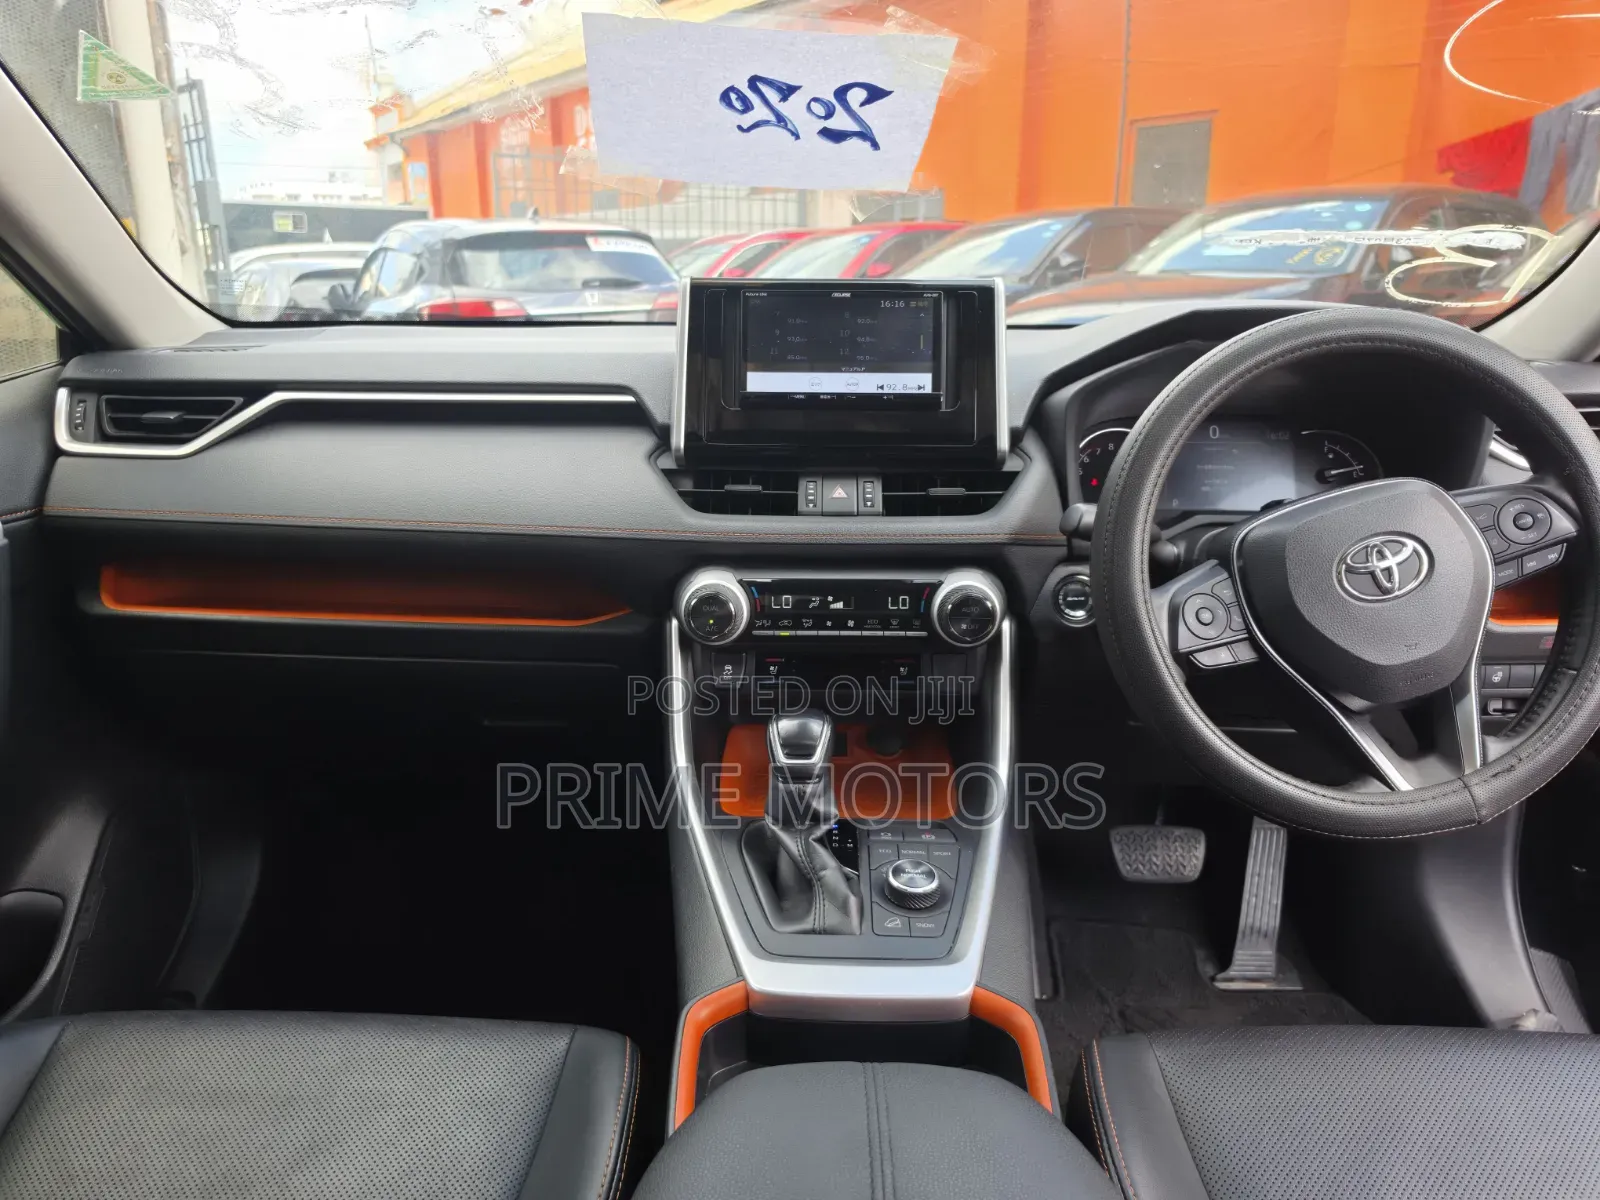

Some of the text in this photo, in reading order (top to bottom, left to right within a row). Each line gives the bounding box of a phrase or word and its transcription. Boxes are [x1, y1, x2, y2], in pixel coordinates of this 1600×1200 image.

[880, 300, 905, 308] 16:16
[1208, 425, 1219, 439] 0
[1108, 443, 1115, 451] 8
[771, 595, 792, 609] LO
[888, 595, 909, 610] LO
